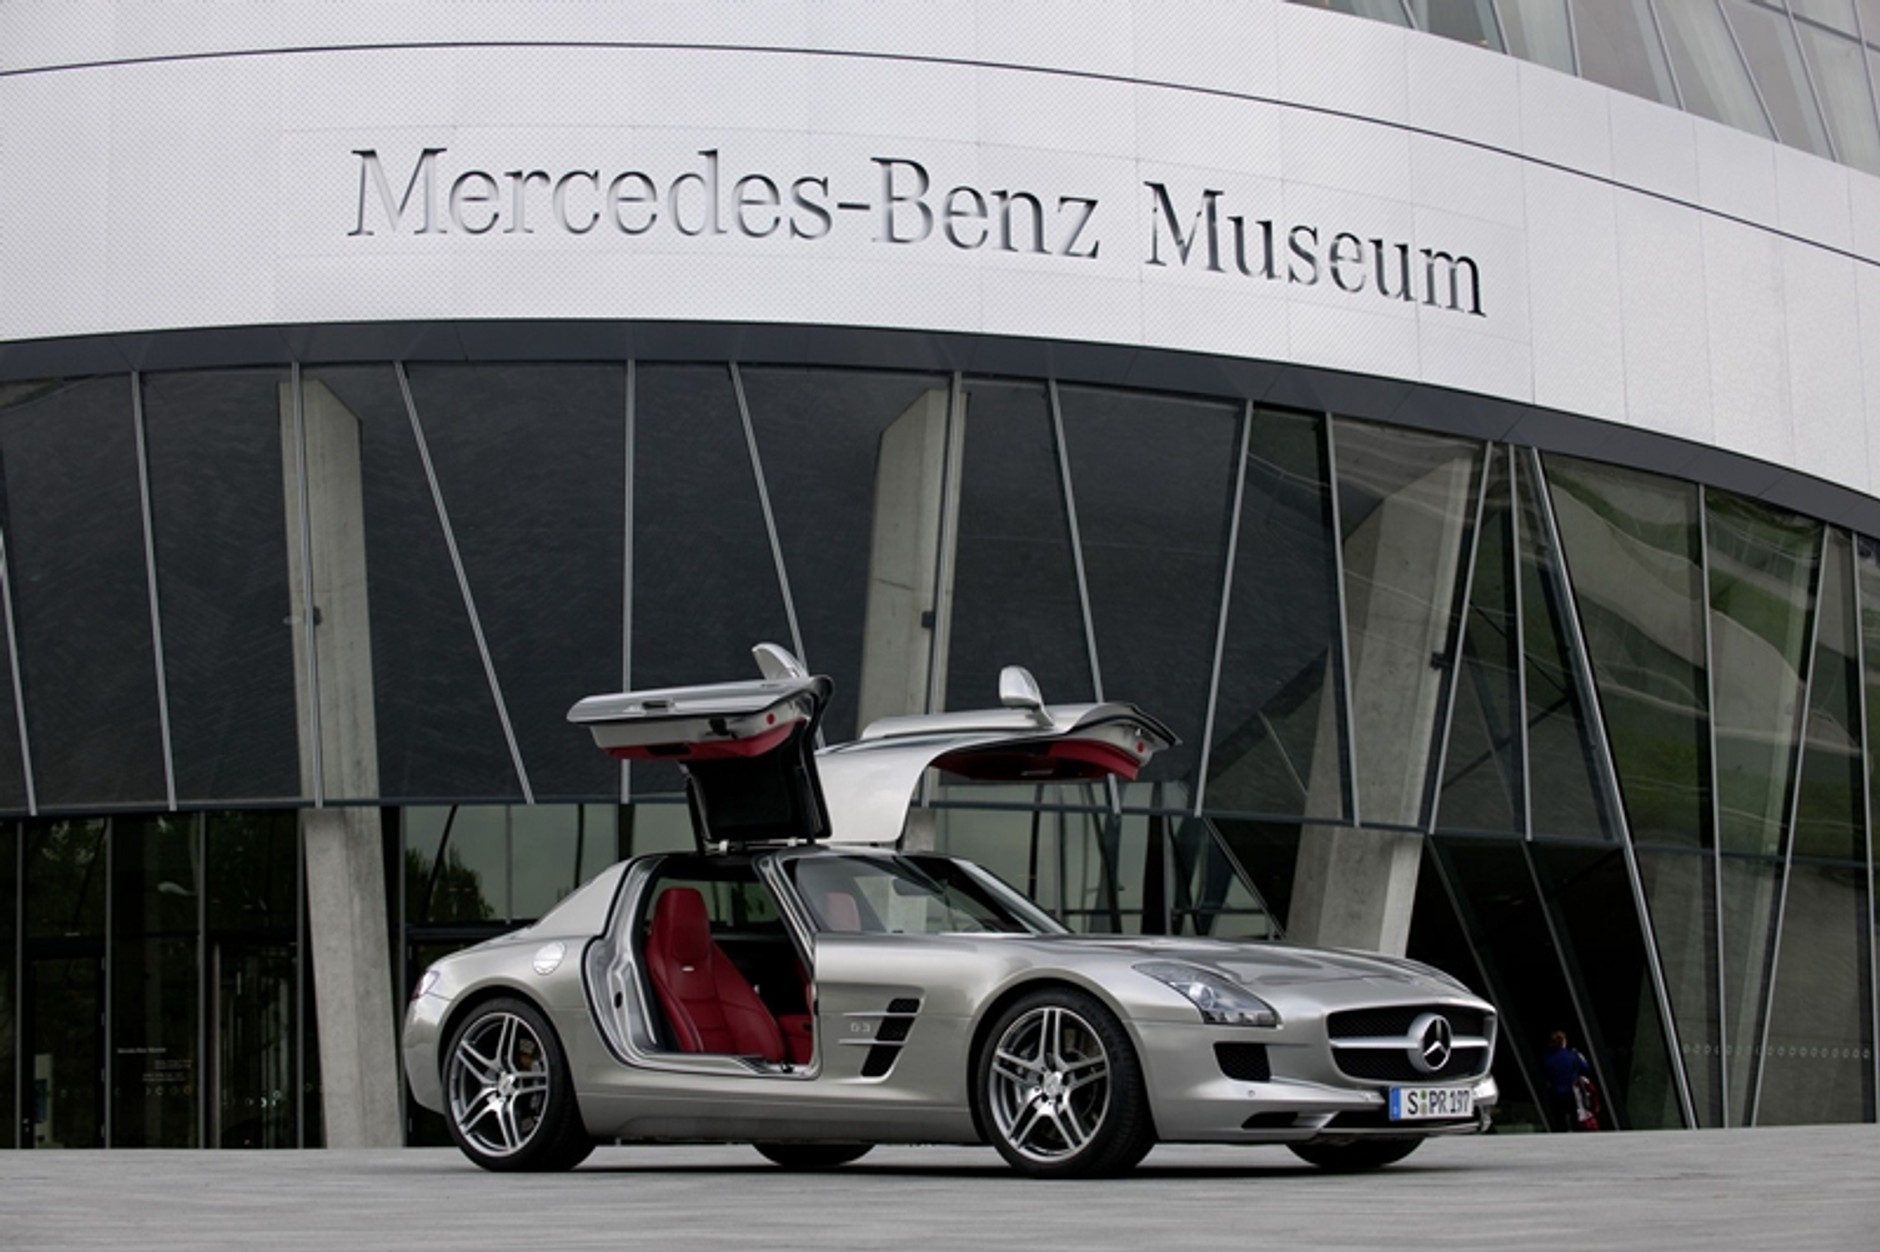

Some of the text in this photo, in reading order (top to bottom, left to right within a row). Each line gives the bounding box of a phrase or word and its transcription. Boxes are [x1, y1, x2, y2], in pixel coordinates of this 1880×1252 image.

[347, 147, 1487, 317] Mercedes-Benz Museum
[1407, 1091, 1418, 1115] S
